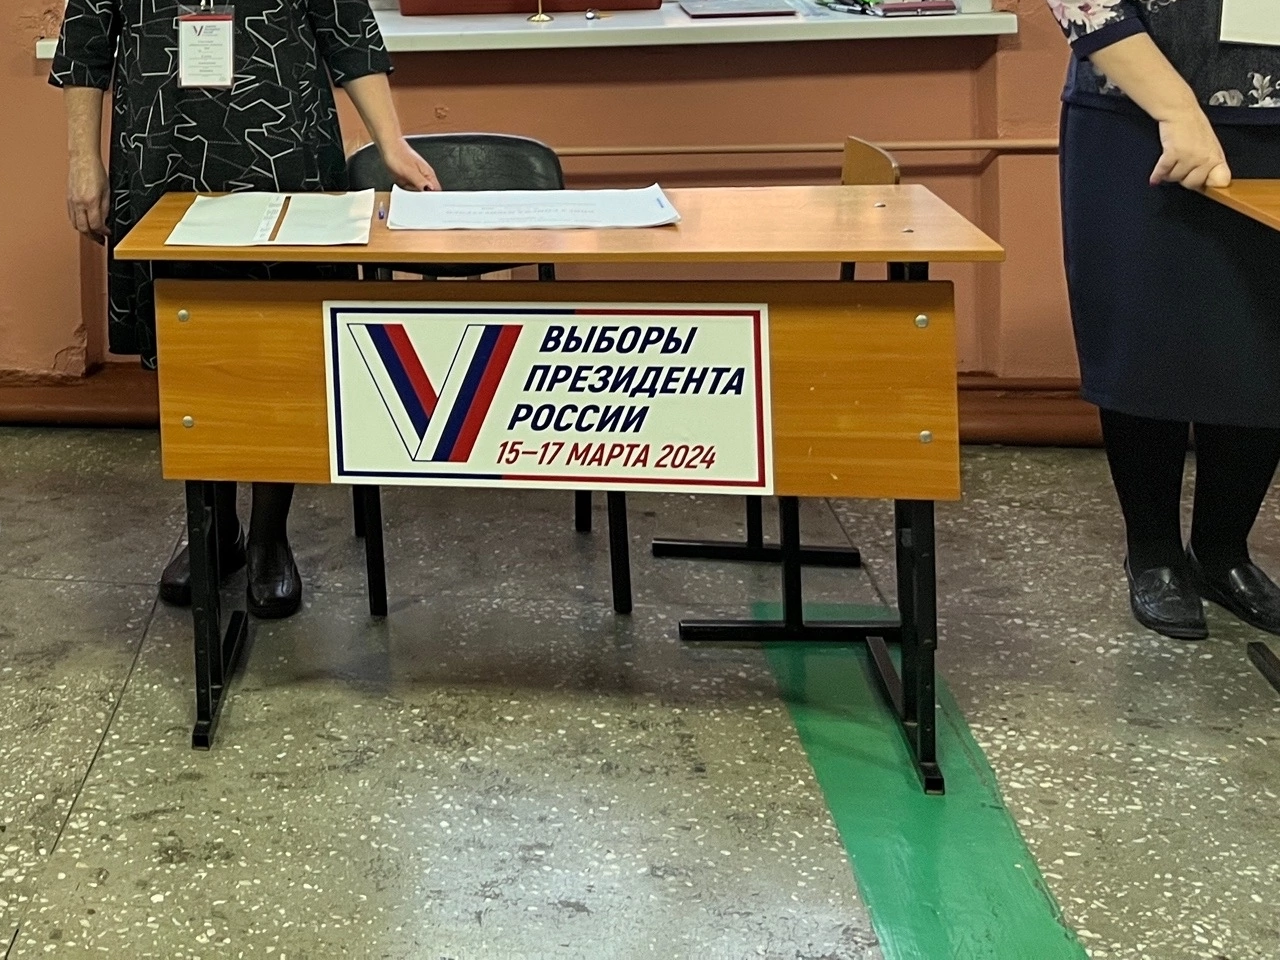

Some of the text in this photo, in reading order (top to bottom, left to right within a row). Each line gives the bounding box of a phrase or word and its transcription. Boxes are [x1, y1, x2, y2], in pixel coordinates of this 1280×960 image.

[538, 325, 698, 354] ВЫБОРЫ
[523, 364, 746, 398] ПРЕЗИДЕНТА
[507, 403, 649, 432] РОССИИ
[568, 442, 652, 468] МАРТА
[654, 444, 717, 470] 2024
